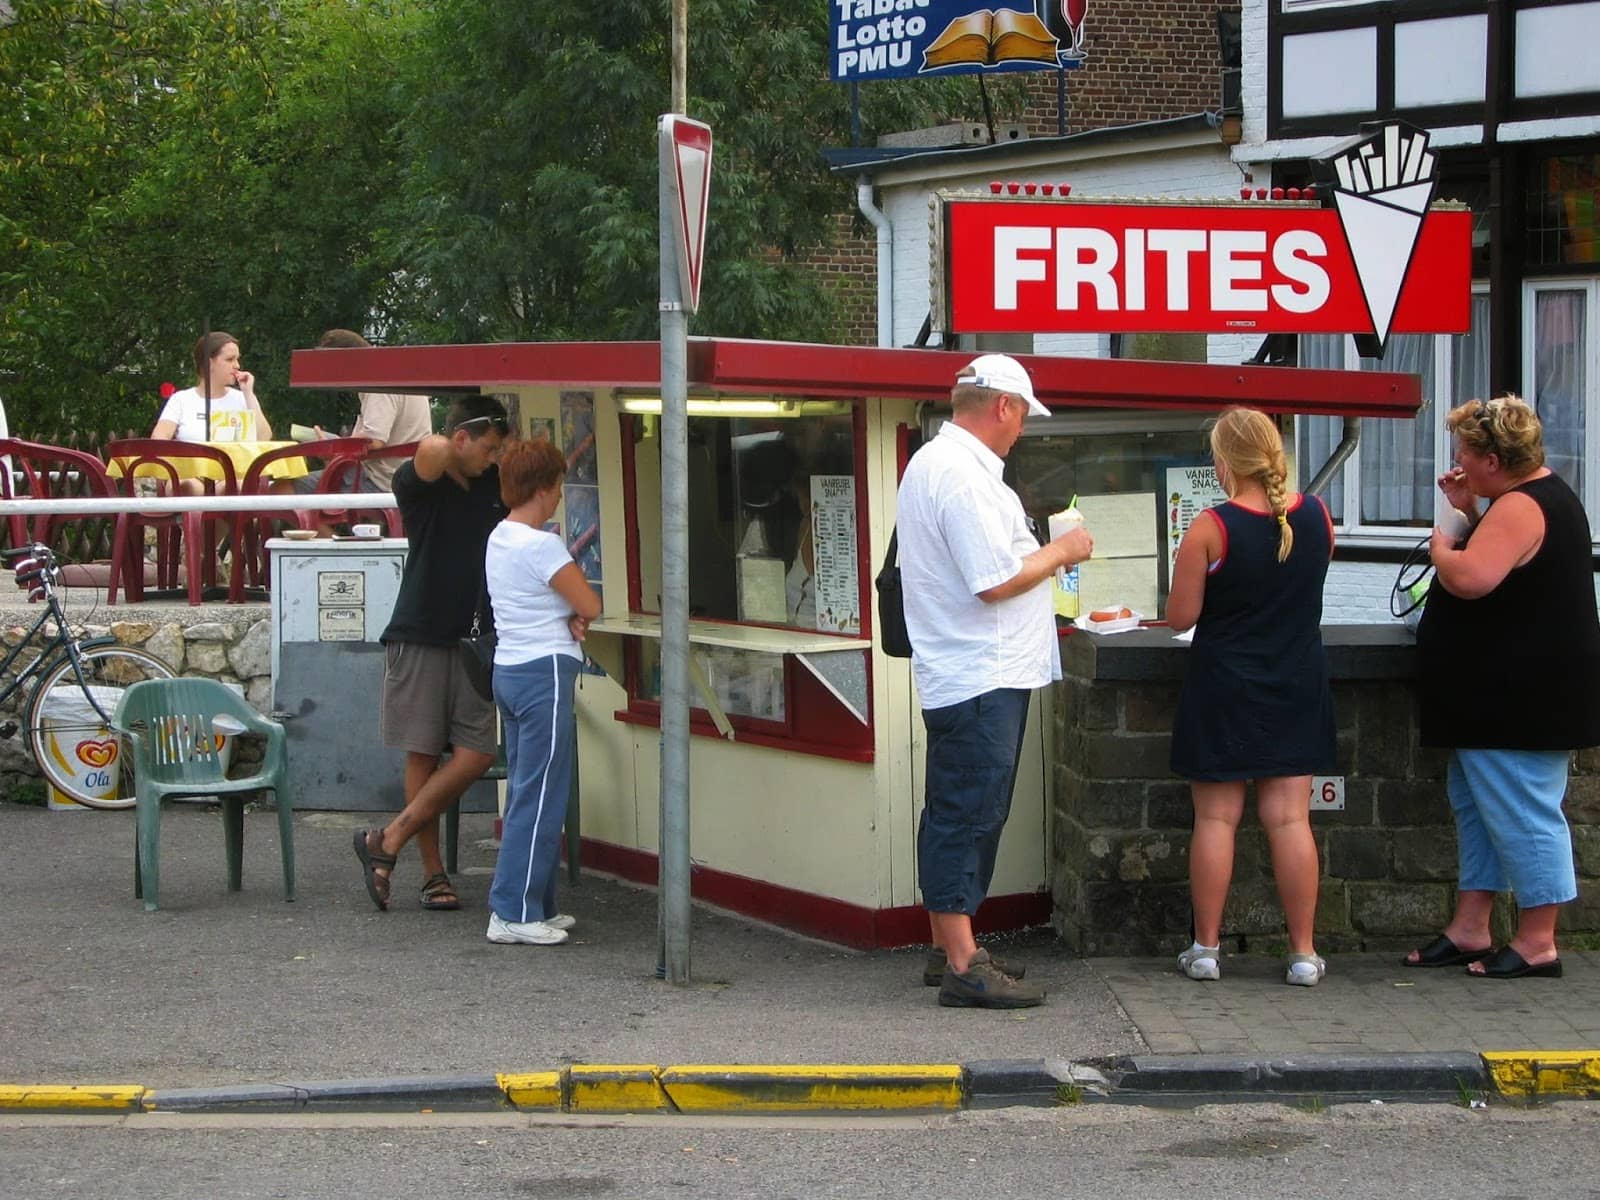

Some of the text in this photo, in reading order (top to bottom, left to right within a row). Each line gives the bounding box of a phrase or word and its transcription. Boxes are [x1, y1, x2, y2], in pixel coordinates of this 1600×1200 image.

[837, 15, 926, 49] Lotto
[838, 40, 912, 77] PMU
[993, 226, 1331, 313] FRITES
[1185, 469, 1217, 480] VANRE
[1192, 479, 1218, 489] SNAC
[85, 772, 110, 788] Ola
